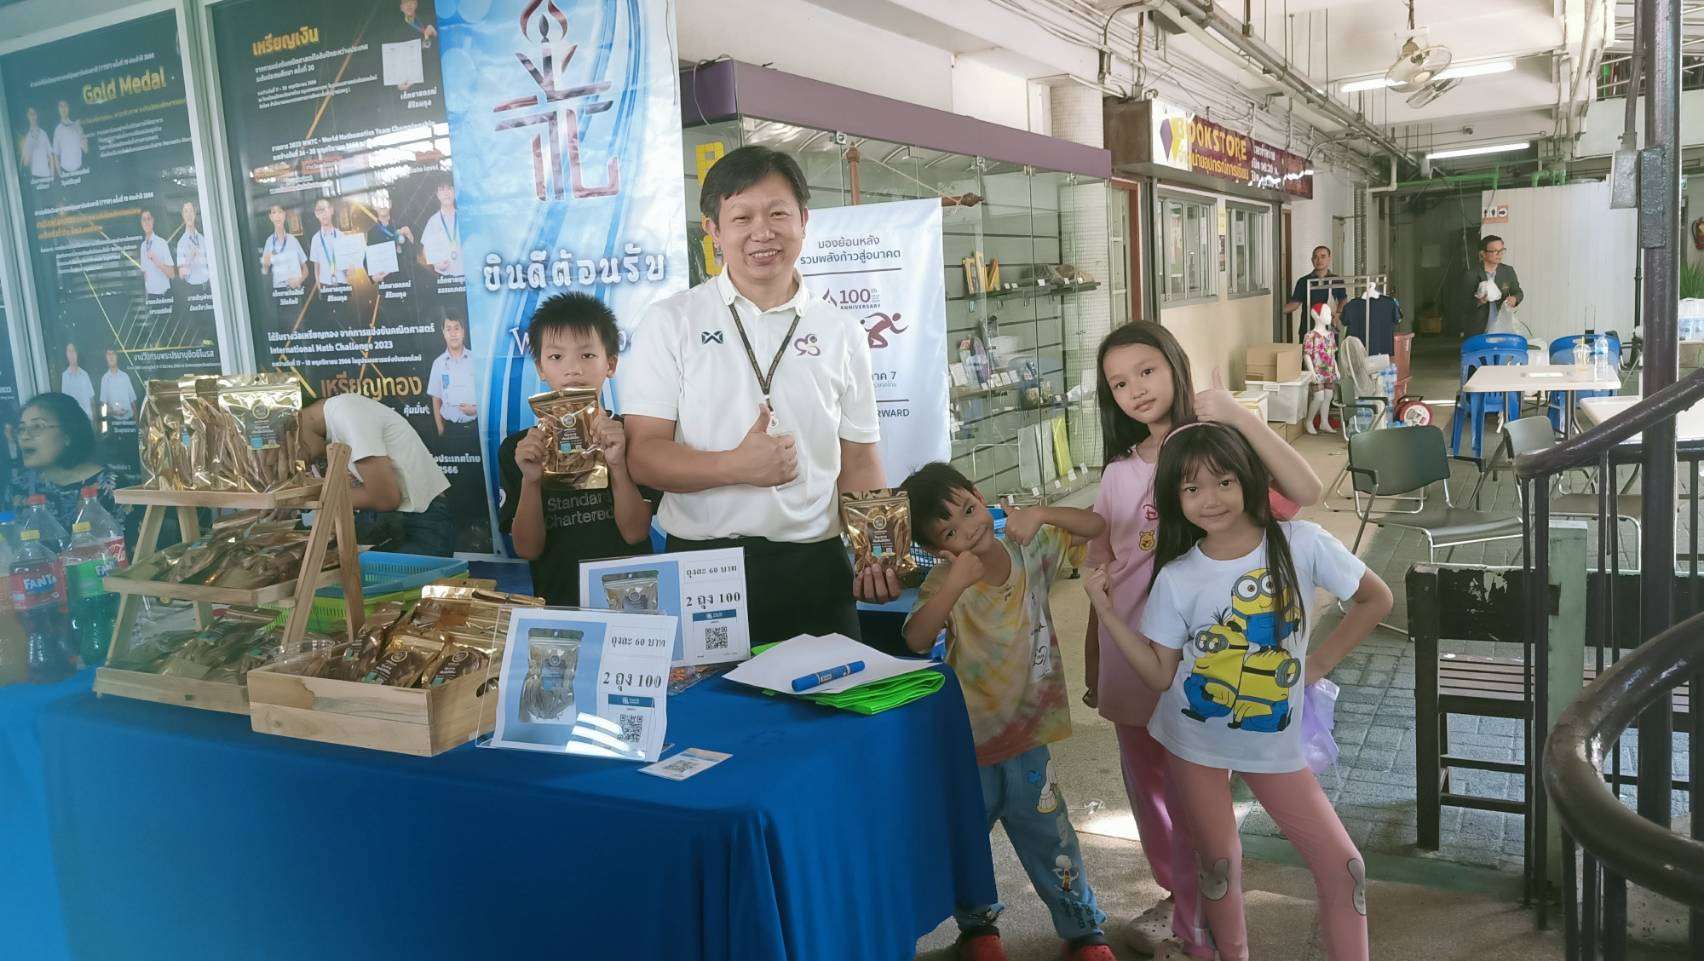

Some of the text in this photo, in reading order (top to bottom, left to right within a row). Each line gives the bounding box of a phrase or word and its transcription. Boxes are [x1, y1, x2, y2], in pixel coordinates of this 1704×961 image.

[251, 25, 319, 56] เหรียญเงิน
[82, 78, 118, 104] Gold
[119, 66, 167, 96] Medal
[818, 234, 880, 249] มองย้อนหลัง
[800, 248, 901, 266] รวมพลังก้าวสู่อนาคต
[483, 242, 666, 291] ยินดีต้อนรับ
[839, 288, 871, 304] 100
[270, 340, 394, 355] International Math Challenge 2023
[890, 371, 896, 380] 7
[320, 371, 423, 400] เหรียญทอง
[547, 493, 602, 511] Standar
[686, 565, 737, 578] ถุงละ 60 บาท
[686, 591, 741, 609] 2 ถุง 100
[611, 636, 666, 648] ถุงละ 60 บาท
[603, 671, 662, 692] 2 ถุง 100
